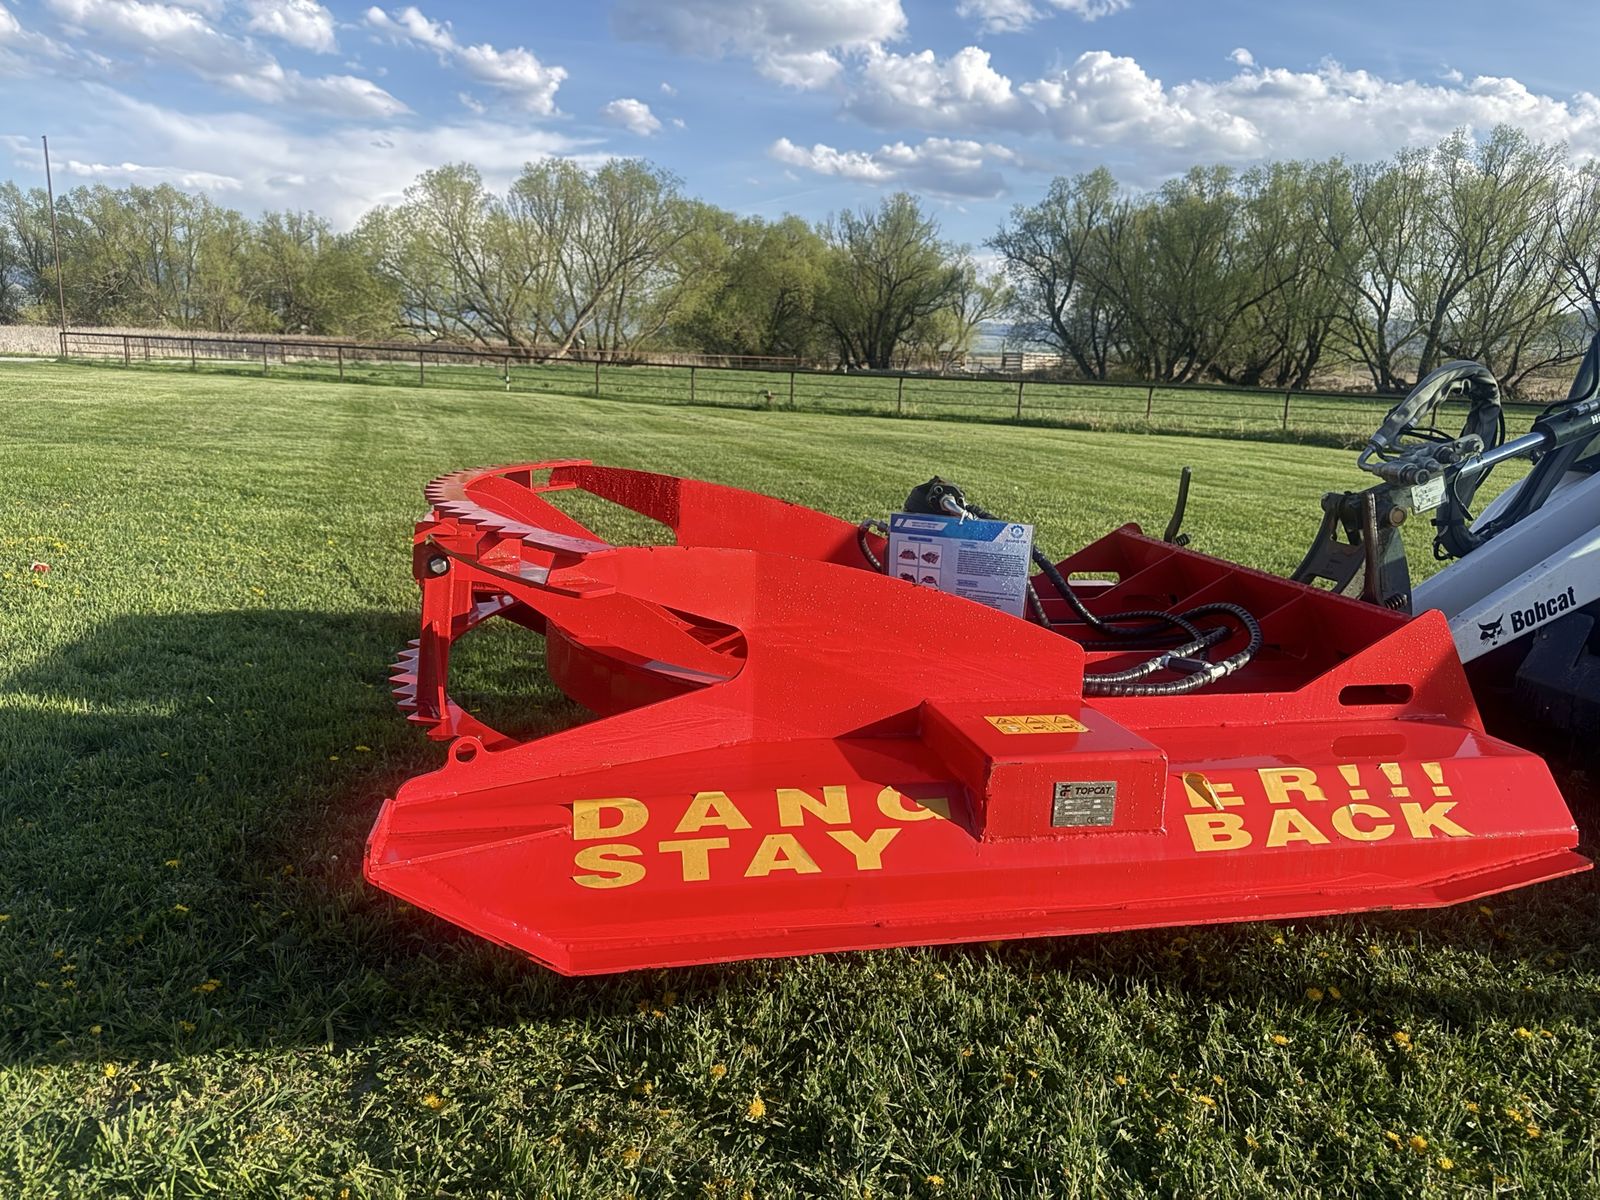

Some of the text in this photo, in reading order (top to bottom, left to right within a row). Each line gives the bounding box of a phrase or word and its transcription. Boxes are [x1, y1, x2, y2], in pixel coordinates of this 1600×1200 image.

[1511, 586, 1577, 634] Bobcat
[572, 761, 1453, 840] DANG ER!!!
[1075, 786, 1112, 795] TOPCAT
[572, 801, 1475, 889] STAY BACK
